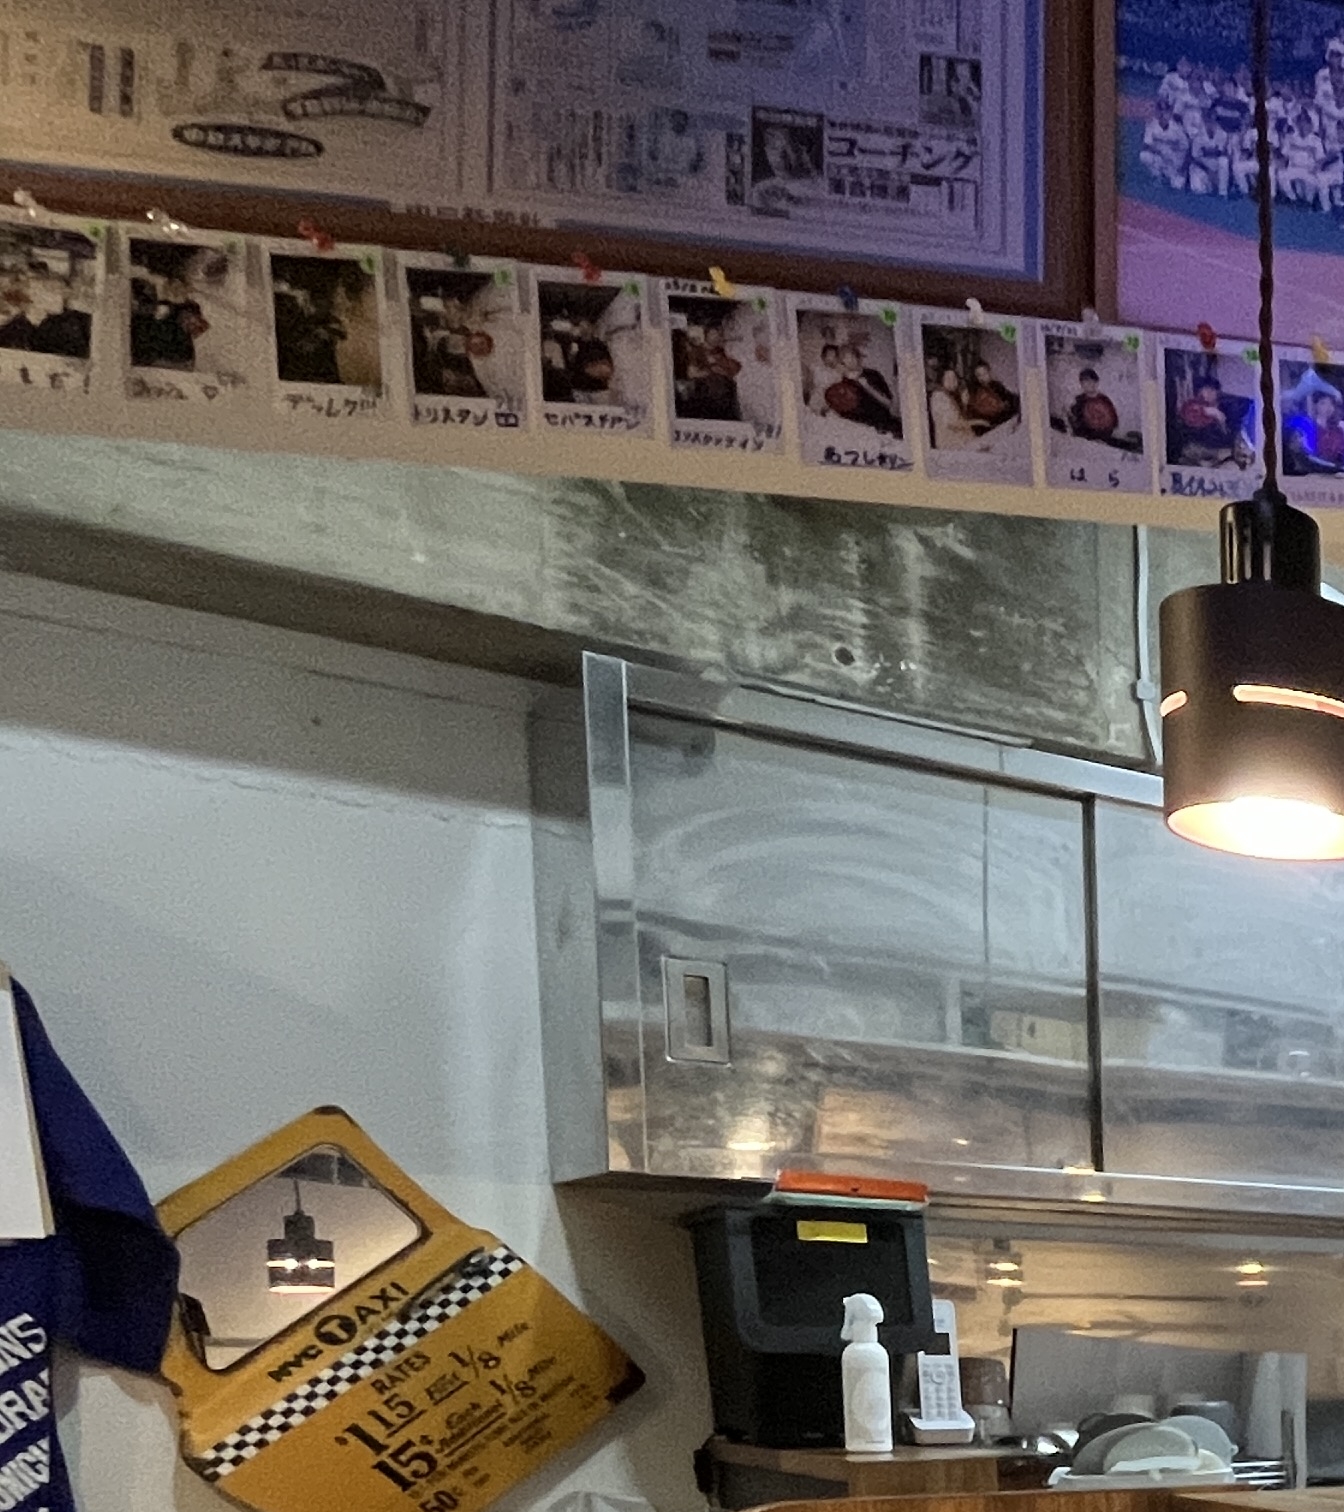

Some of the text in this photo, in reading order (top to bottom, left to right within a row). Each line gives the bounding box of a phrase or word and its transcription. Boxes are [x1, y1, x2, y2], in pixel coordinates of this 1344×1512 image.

[267, 1281, 409, 1383] NYC TAXI
[370, 1351, 432, 1396] RATES
